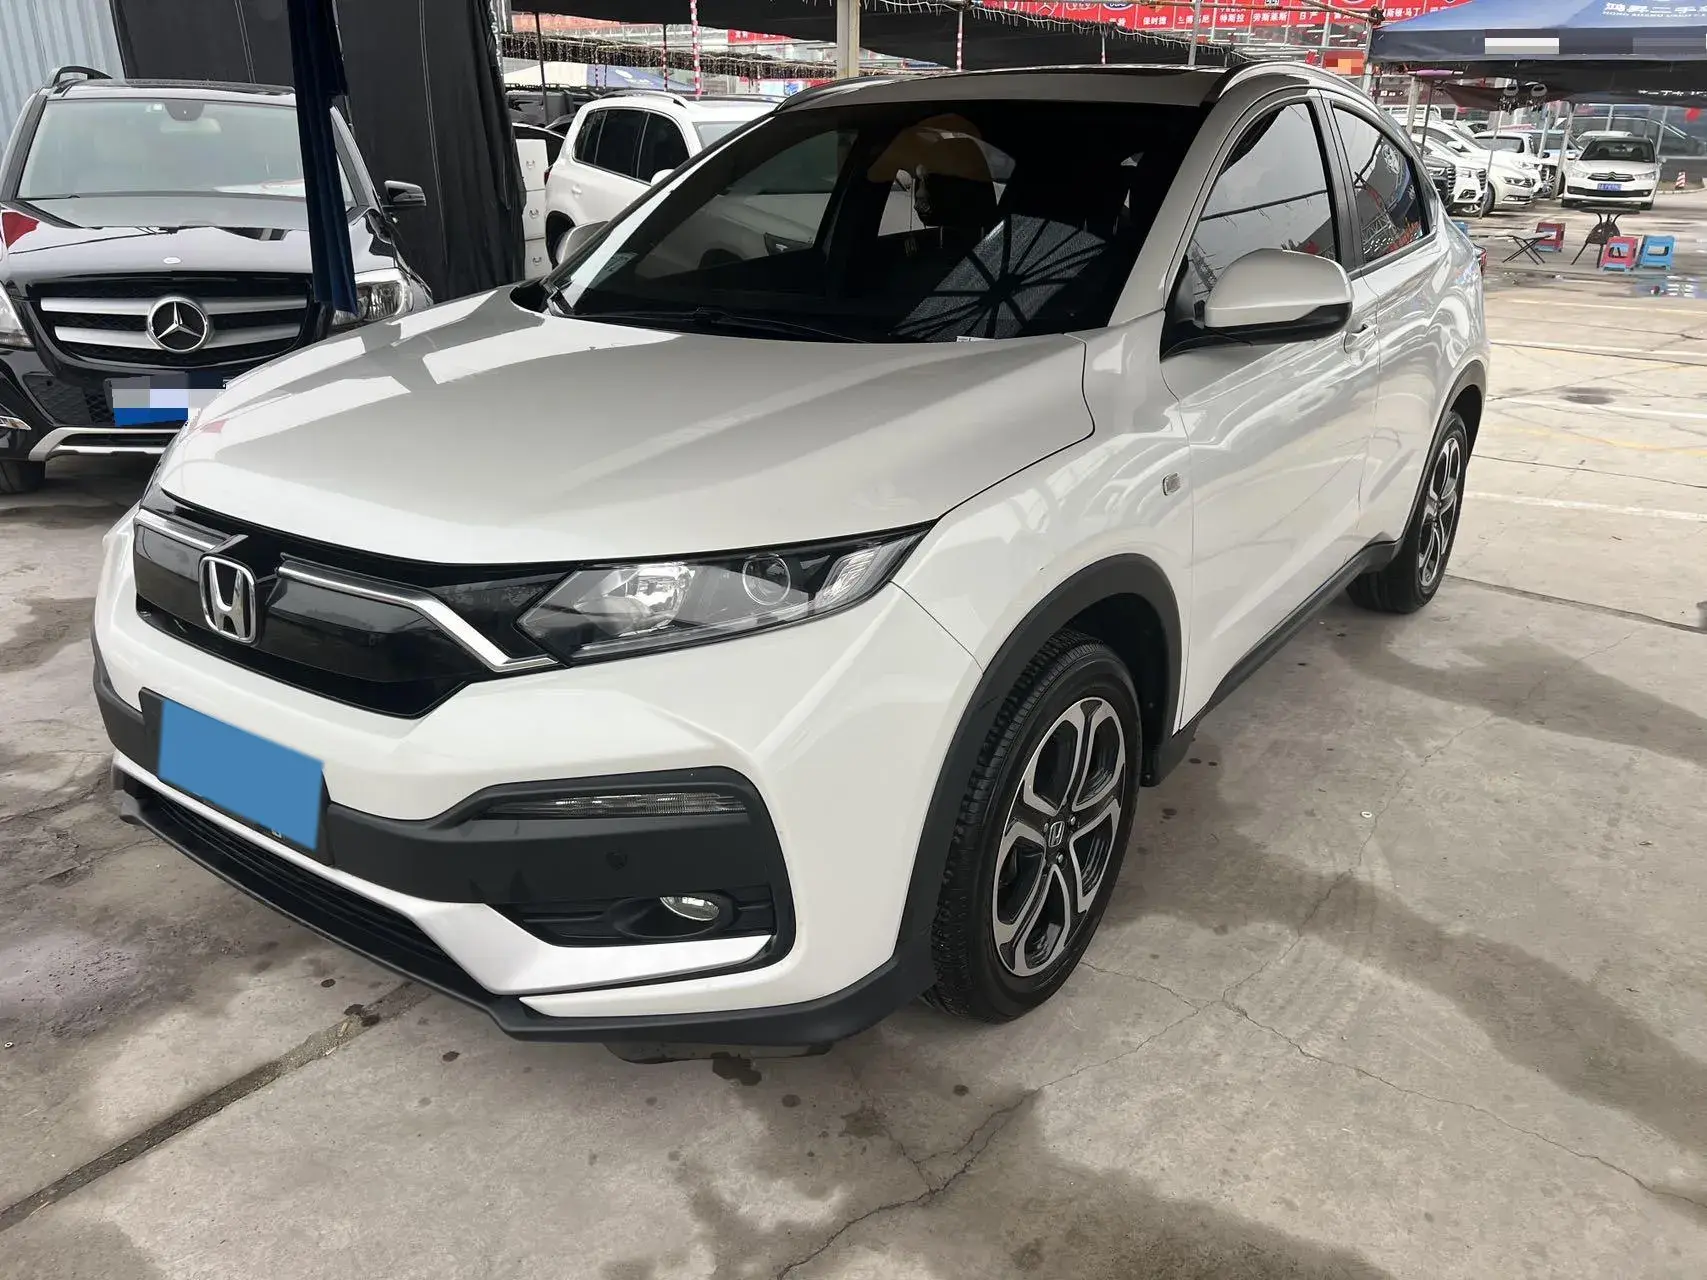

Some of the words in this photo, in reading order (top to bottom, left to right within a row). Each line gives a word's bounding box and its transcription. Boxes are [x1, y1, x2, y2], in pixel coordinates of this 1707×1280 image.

[1143, 16, 1168, 25] 保时捷
[1177, 14, 1210, 24] 兰博尼
[1219, 13, 1246, 23] 特斯拉
[1252, 11, 1288, 22] 劳斯莱斯
